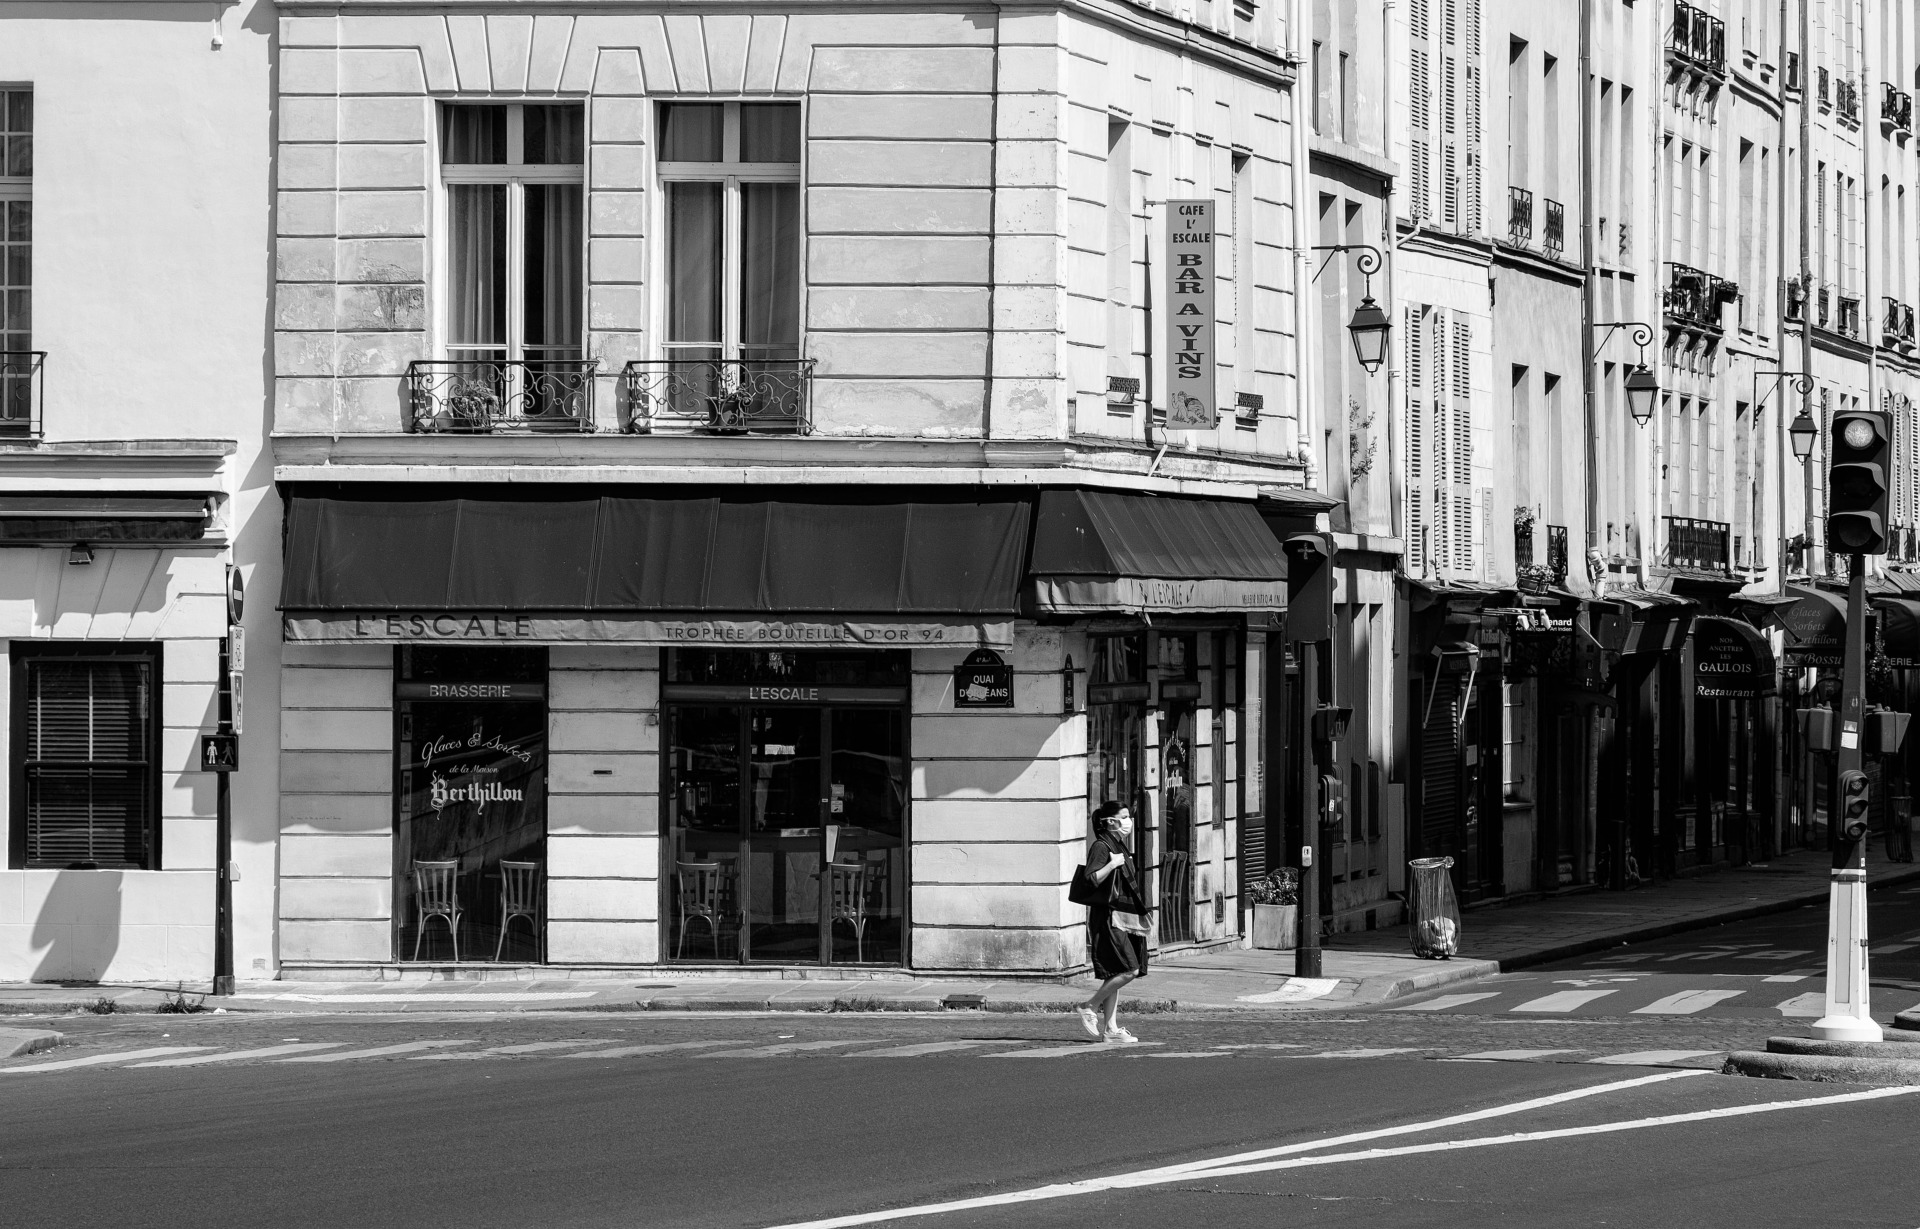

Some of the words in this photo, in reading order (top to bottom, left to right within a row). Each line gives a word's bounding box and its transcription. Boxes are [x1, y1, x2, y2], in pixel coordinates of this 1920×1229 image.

[1178, 205, 1204, 216] CAFE
[1186, 219, 1196, 230] L'
[1172, 233, 1211, 243] ESCALE
[1175, 254, 1205, 294] BAR
[1176, 303, 1204, 316] A
[1175, 325, 1205, 379] VINS
[1791, 606, 1821, 619] Glaces
[355, 614, 530, 637] L'ESCALE
[1541, 618, 1573, 626] enard
[1792, 621, 1826, 631] Sorbets
[666, 625, 745, 640] TROPHÉE
[758, 627, 851, 640] BOUTEILLE
[864, 628, 909, 640] D'OR
[922, 629, 944, 640] 94
[1804, 652, 1842, 665] Bossu
[1699, 662, 1752, 673] GAULOIS
[973, 675, 994, 684] QUAI
[429, 684, 511, 697] BRASSERIE
[749, 687, 819, 700] L'ESCALE
[1696, 685, 1755, 697] Restaurant
[421, 735, 462, 768] Glaces
[467, 732, 481, 747] &
[482, 734, 532, 763] Sorbets
[449, 764, 458, 773] de
[460, 764, 469, 773] la
[470, 764, 500, 773] Maison
[430, 769, 524, 820] Berthillon
